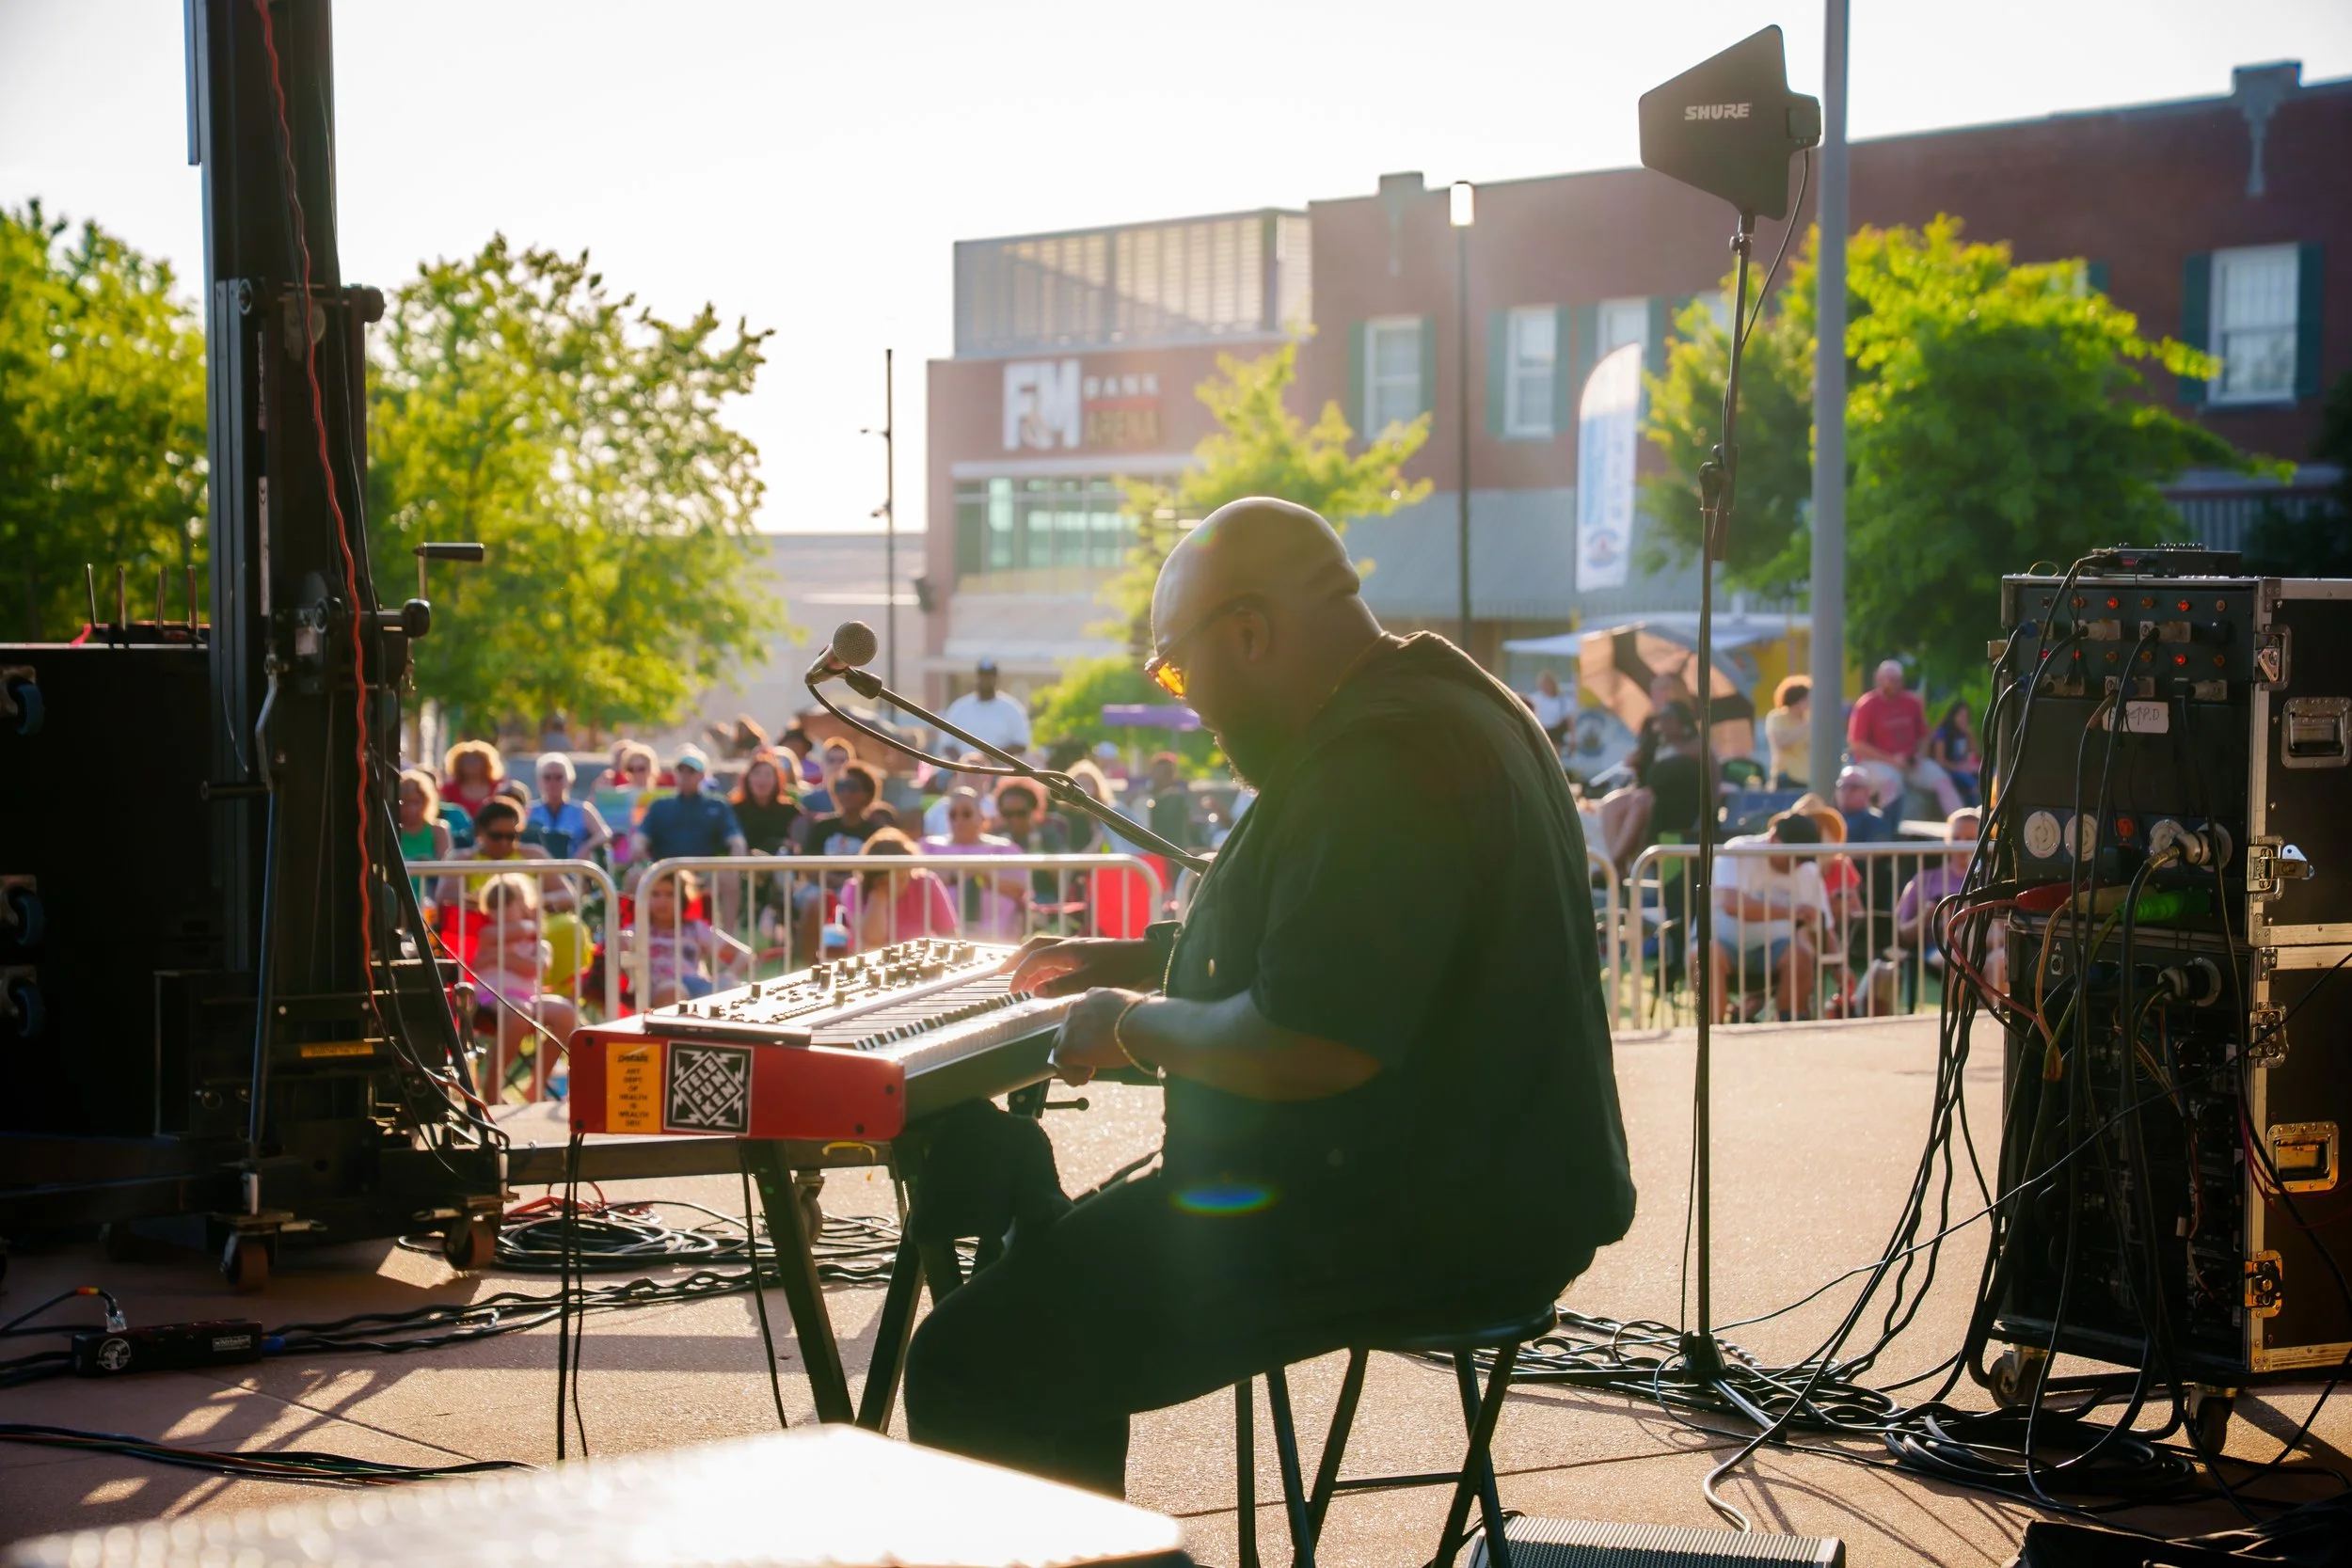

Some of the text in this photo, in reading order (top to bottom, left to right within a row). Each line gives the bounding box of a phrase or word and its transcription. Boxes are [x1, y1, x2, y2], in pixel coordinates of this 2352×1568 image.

[1684, 103, 1750, 121] SHURE
[680, 1058, 718, 1094] TELE
[691, 1069, 727, 1105] FUN
[701, 1081, 737, 1117] KEN
